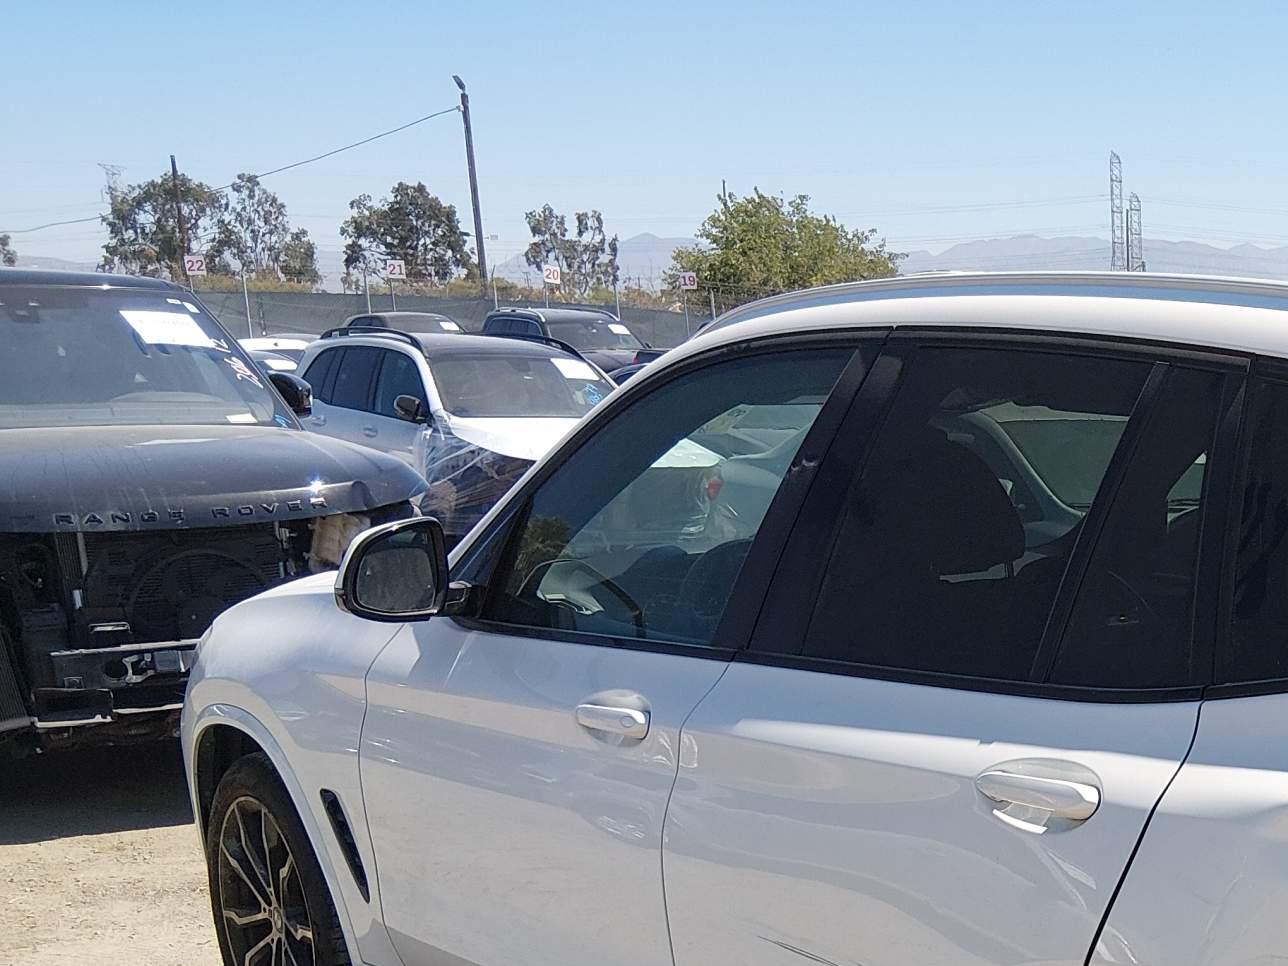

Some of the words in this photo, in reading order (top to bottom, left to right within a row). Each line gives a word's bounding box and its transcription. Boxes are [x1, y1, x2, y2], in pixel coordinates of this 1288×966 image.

[186, 259, 205, 272] 22
[388, 263, 403, 276] 21
[544, 268, 559, 280] 20
[681, 275, 696, 287] 19
[53, 511, 185, 525] RANGE
[211, 497, 328, 518] ROVER
